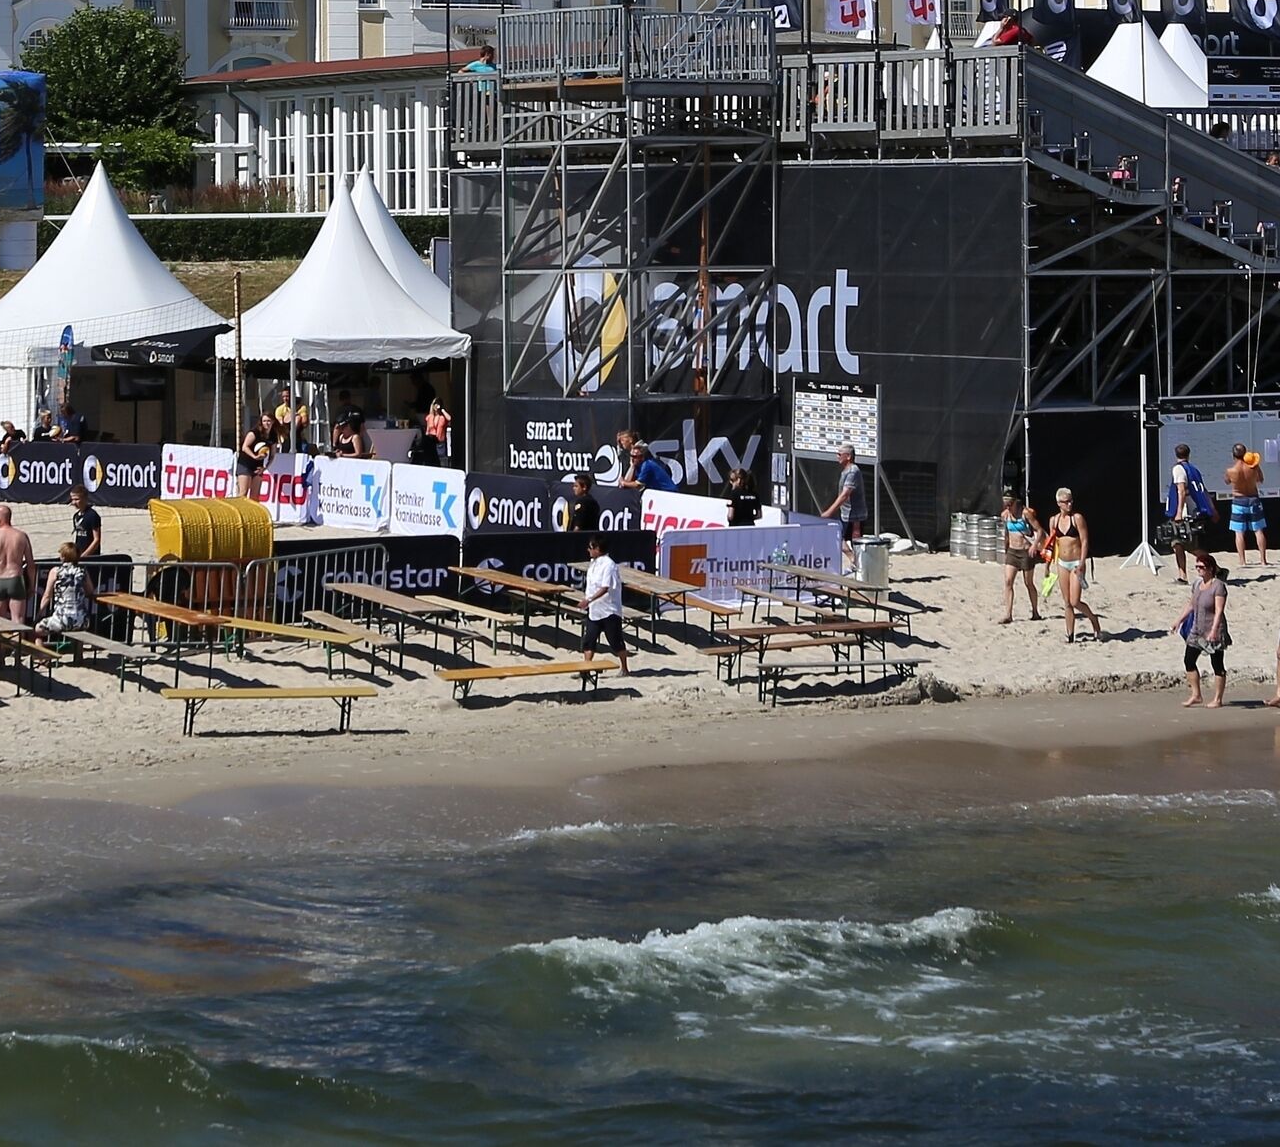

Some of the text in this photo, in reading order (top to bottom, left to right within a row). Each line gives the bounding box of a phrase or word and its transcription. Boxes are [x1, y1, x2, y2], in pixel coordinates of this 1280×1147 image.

[526, 419, 573, 442] smart
[510, 444, 593, 472] beach tour
[19, 459, 72, 486] smart
[106, 460, 157, 489] smart
[165, 453, 229, 498] tipico
[489, 496, 542, 529] smart
[599, 506, 632, 531] art
